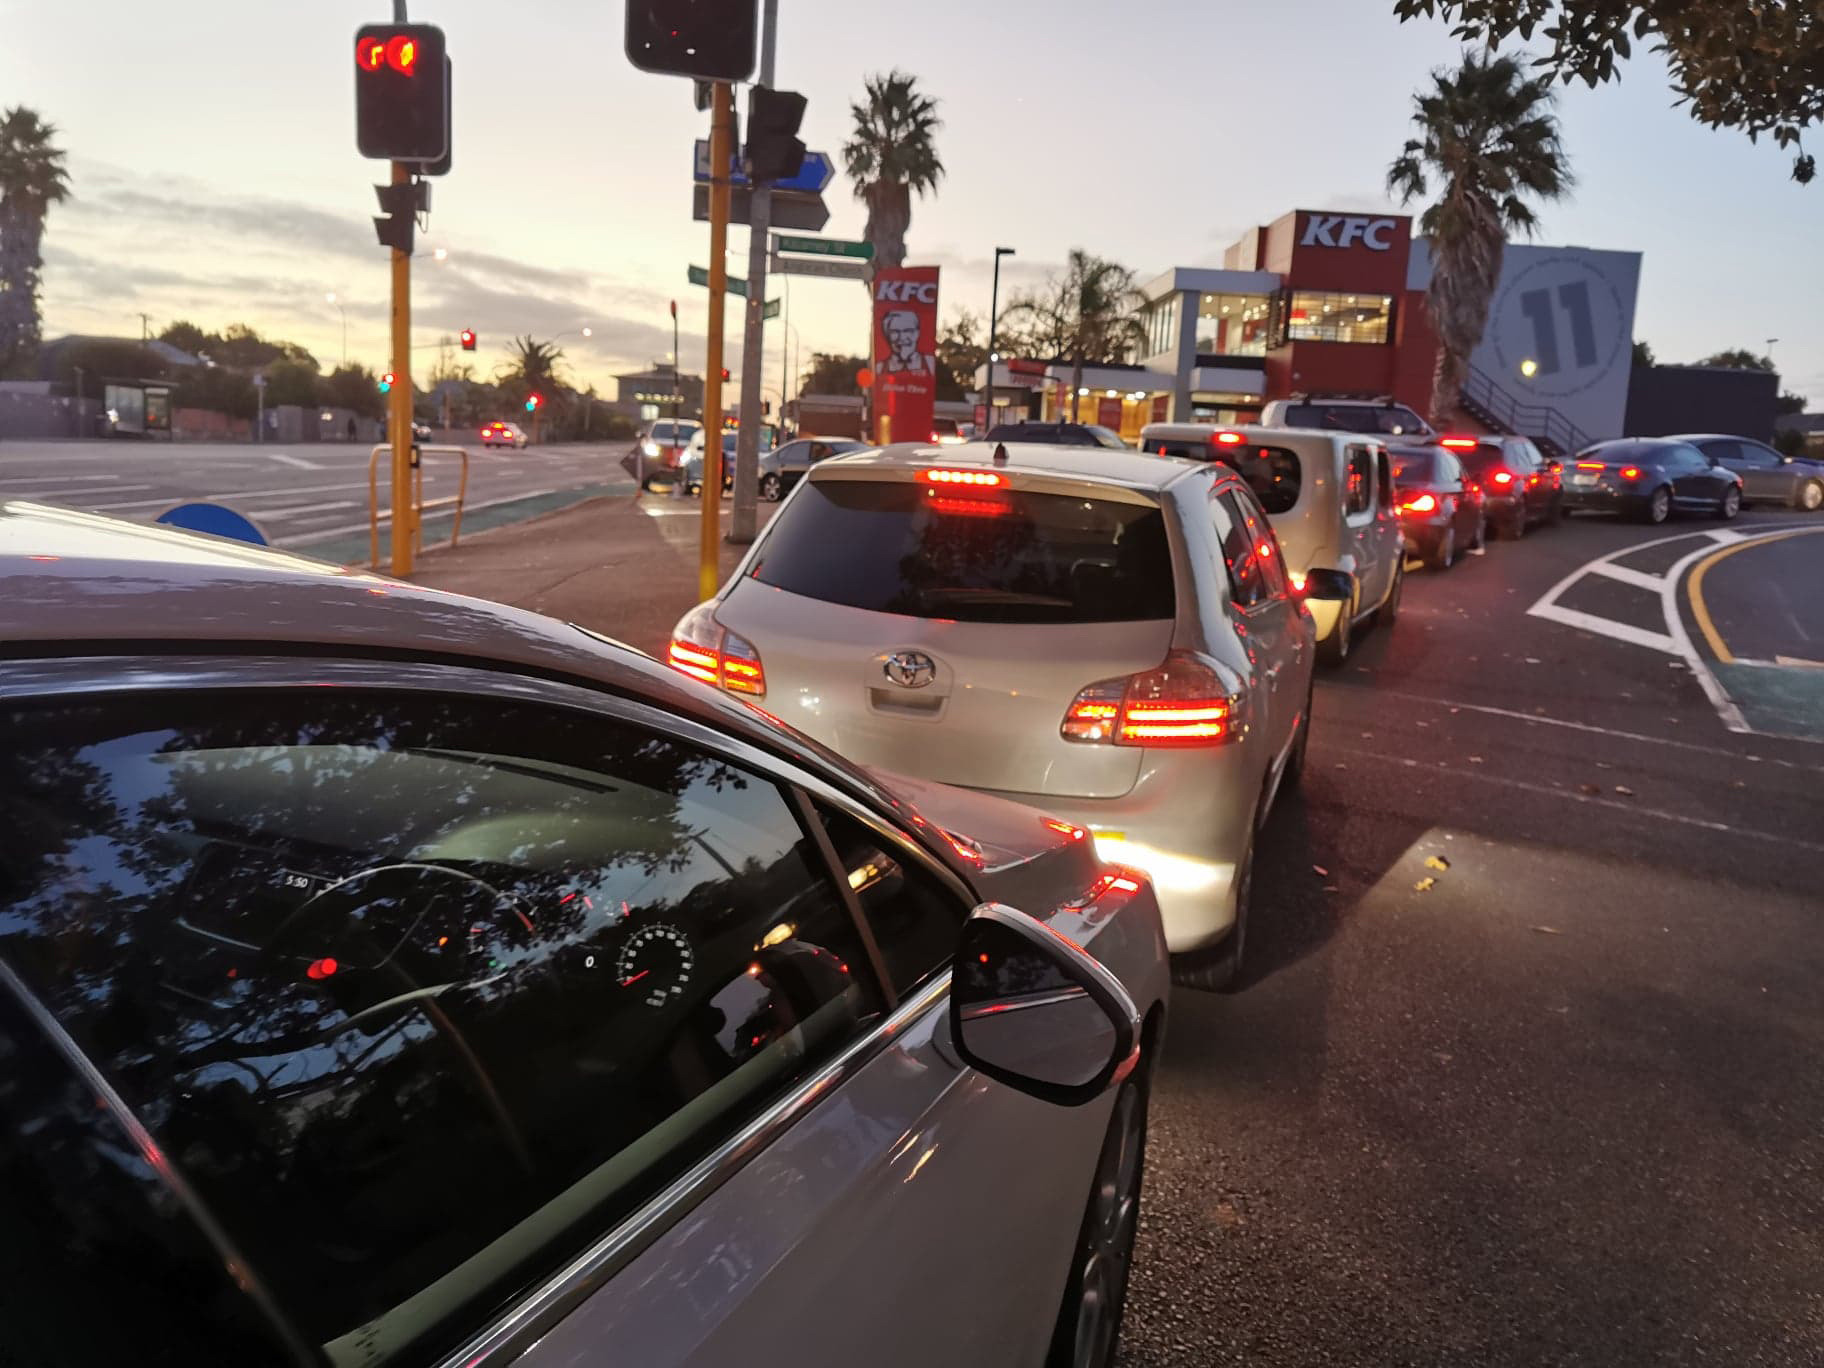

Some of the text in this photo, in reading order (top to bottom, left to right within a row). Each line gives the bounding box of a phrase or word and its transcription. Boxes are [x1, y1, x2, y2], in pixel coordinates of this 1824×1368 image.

[1301, 215, 1396, 250] KFC
[877, 281, 936, 304] KFC
[1520, 280, 1598, 376] 11
